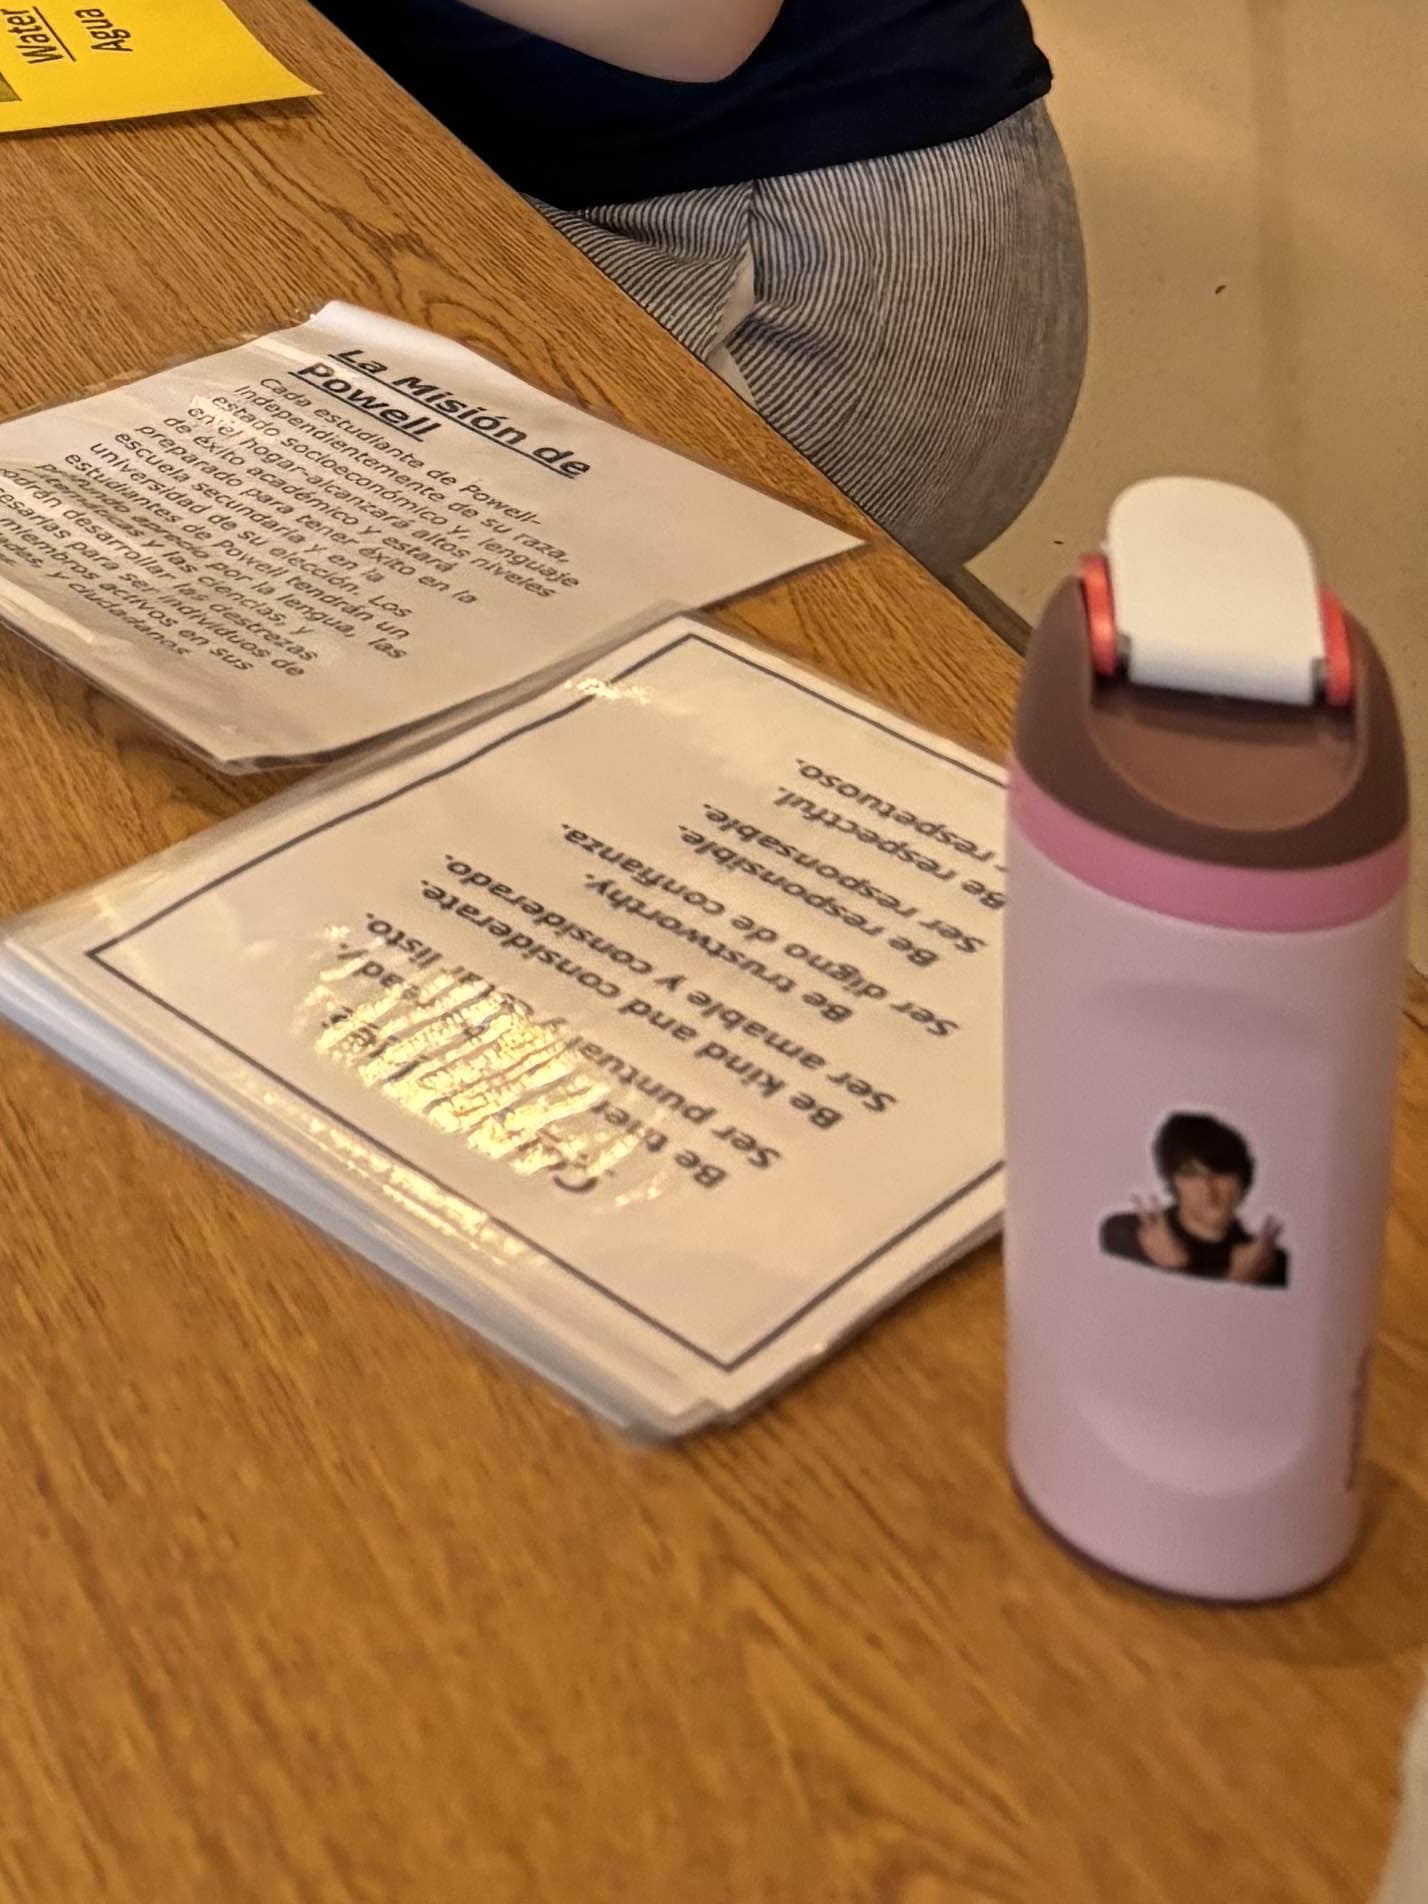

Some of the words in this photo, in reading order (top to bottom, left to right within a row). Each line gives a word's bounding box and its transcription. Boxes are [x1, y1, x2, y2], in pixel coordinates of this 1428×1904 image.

[0, 7, 62, 66] Water
[72, 7, 134, 54] Agua
[297, 362, 440, 434] Powell
[334, 349, 387, 374] La
[391, 376, 526, 444] Misión
[532, 446, 590, 475] de
[235, 386, 444, 501] Independientemente
[447, 501, 478, 518] de
[480, 517, 512, 534] su
[512, 532, 568, 563] raza,
[259, 377, 312, 407] Cada
[313, 408, 423, 468] estudiante
[425, 469, 457, 485] de
[458, 484, 539, 524] Powell-
[211, 396, 280, 436] estado
[280, 437, 447, 524] socioeconómico
[446, 524, 470, 539] y,
[477, 537, 578, 586] lenguaje
[775, 787, 955, 880] respectful.
[797, 759, 993, 861] respetuoso.
[563, 824, 724, 915] confianza.
[680, 826, 883, 935] responsible.
[704, 804, 916, 917] responsable.
[446, 855, 652, 974] considerado.
[961, 879, 1004, 909] Be
[366, 913, 441, 968] listo.
[422, 880, 619, 997] considerate.
[586, 874, 794, 992] trustworthy.
[731, 915, 778, 942] de
[888, 936, 938, 967] Be
[919, 919, 986, 953] Ser
[654, 975, 686, 992] y
[783, 943, 887, 999] digno
[617, 998, 696, 1040] and
[687, 991, 825, 1069] amable
[802, 992, 852, 1022] Be
[890, 1002, 958, 1036] Ser
[564, 1036, 716, 1124] puntual
[694, 1041, 784, 1097] kind
[827, 1072, 896, 1112] Ser
[790, 1093, 842, 1129] Be
[674, 1150, 726, 1188] Be
[712, 1127, 780, 1168] Ser
